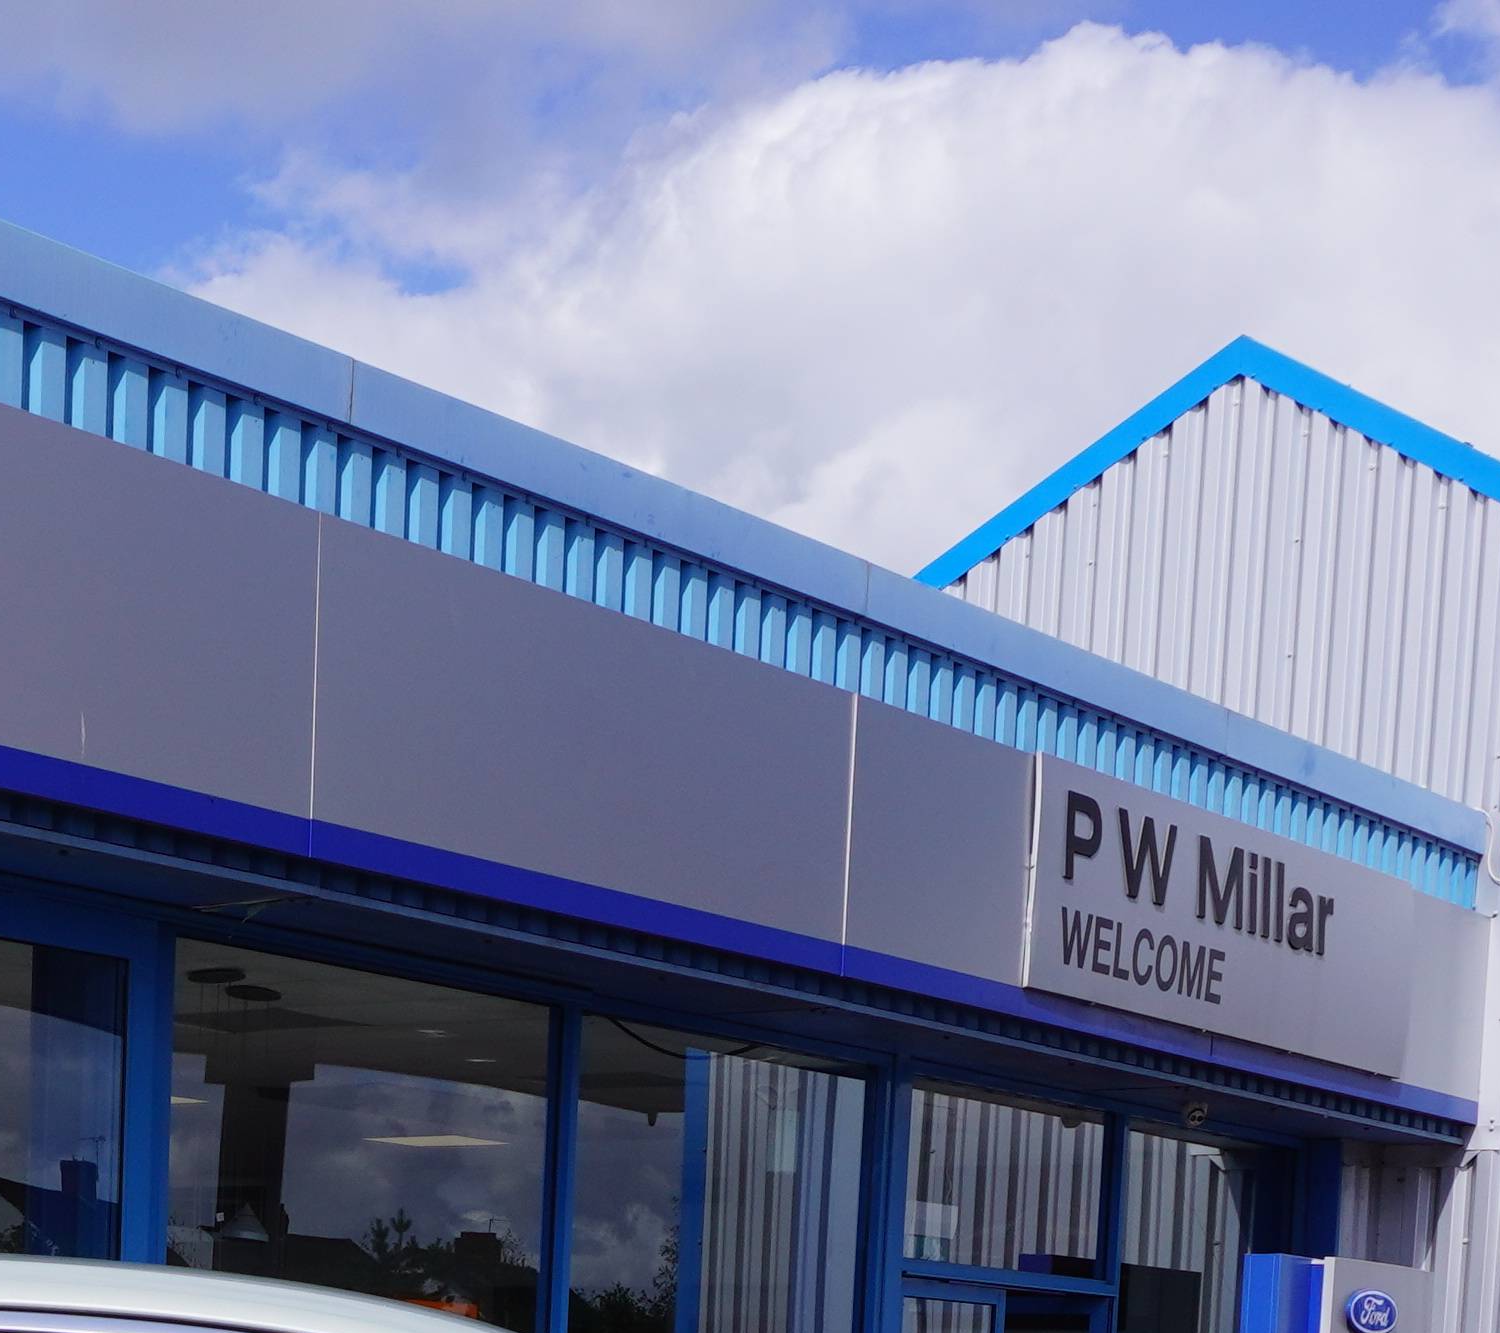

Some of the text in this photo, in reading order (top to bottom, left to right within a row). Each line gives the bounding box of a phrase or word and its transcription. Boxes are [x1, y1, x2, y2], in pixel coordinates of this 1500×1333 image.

[1062, 789, 1335, 957] P W Millar
[1061, 905, 1226, 1005] WELCOME
